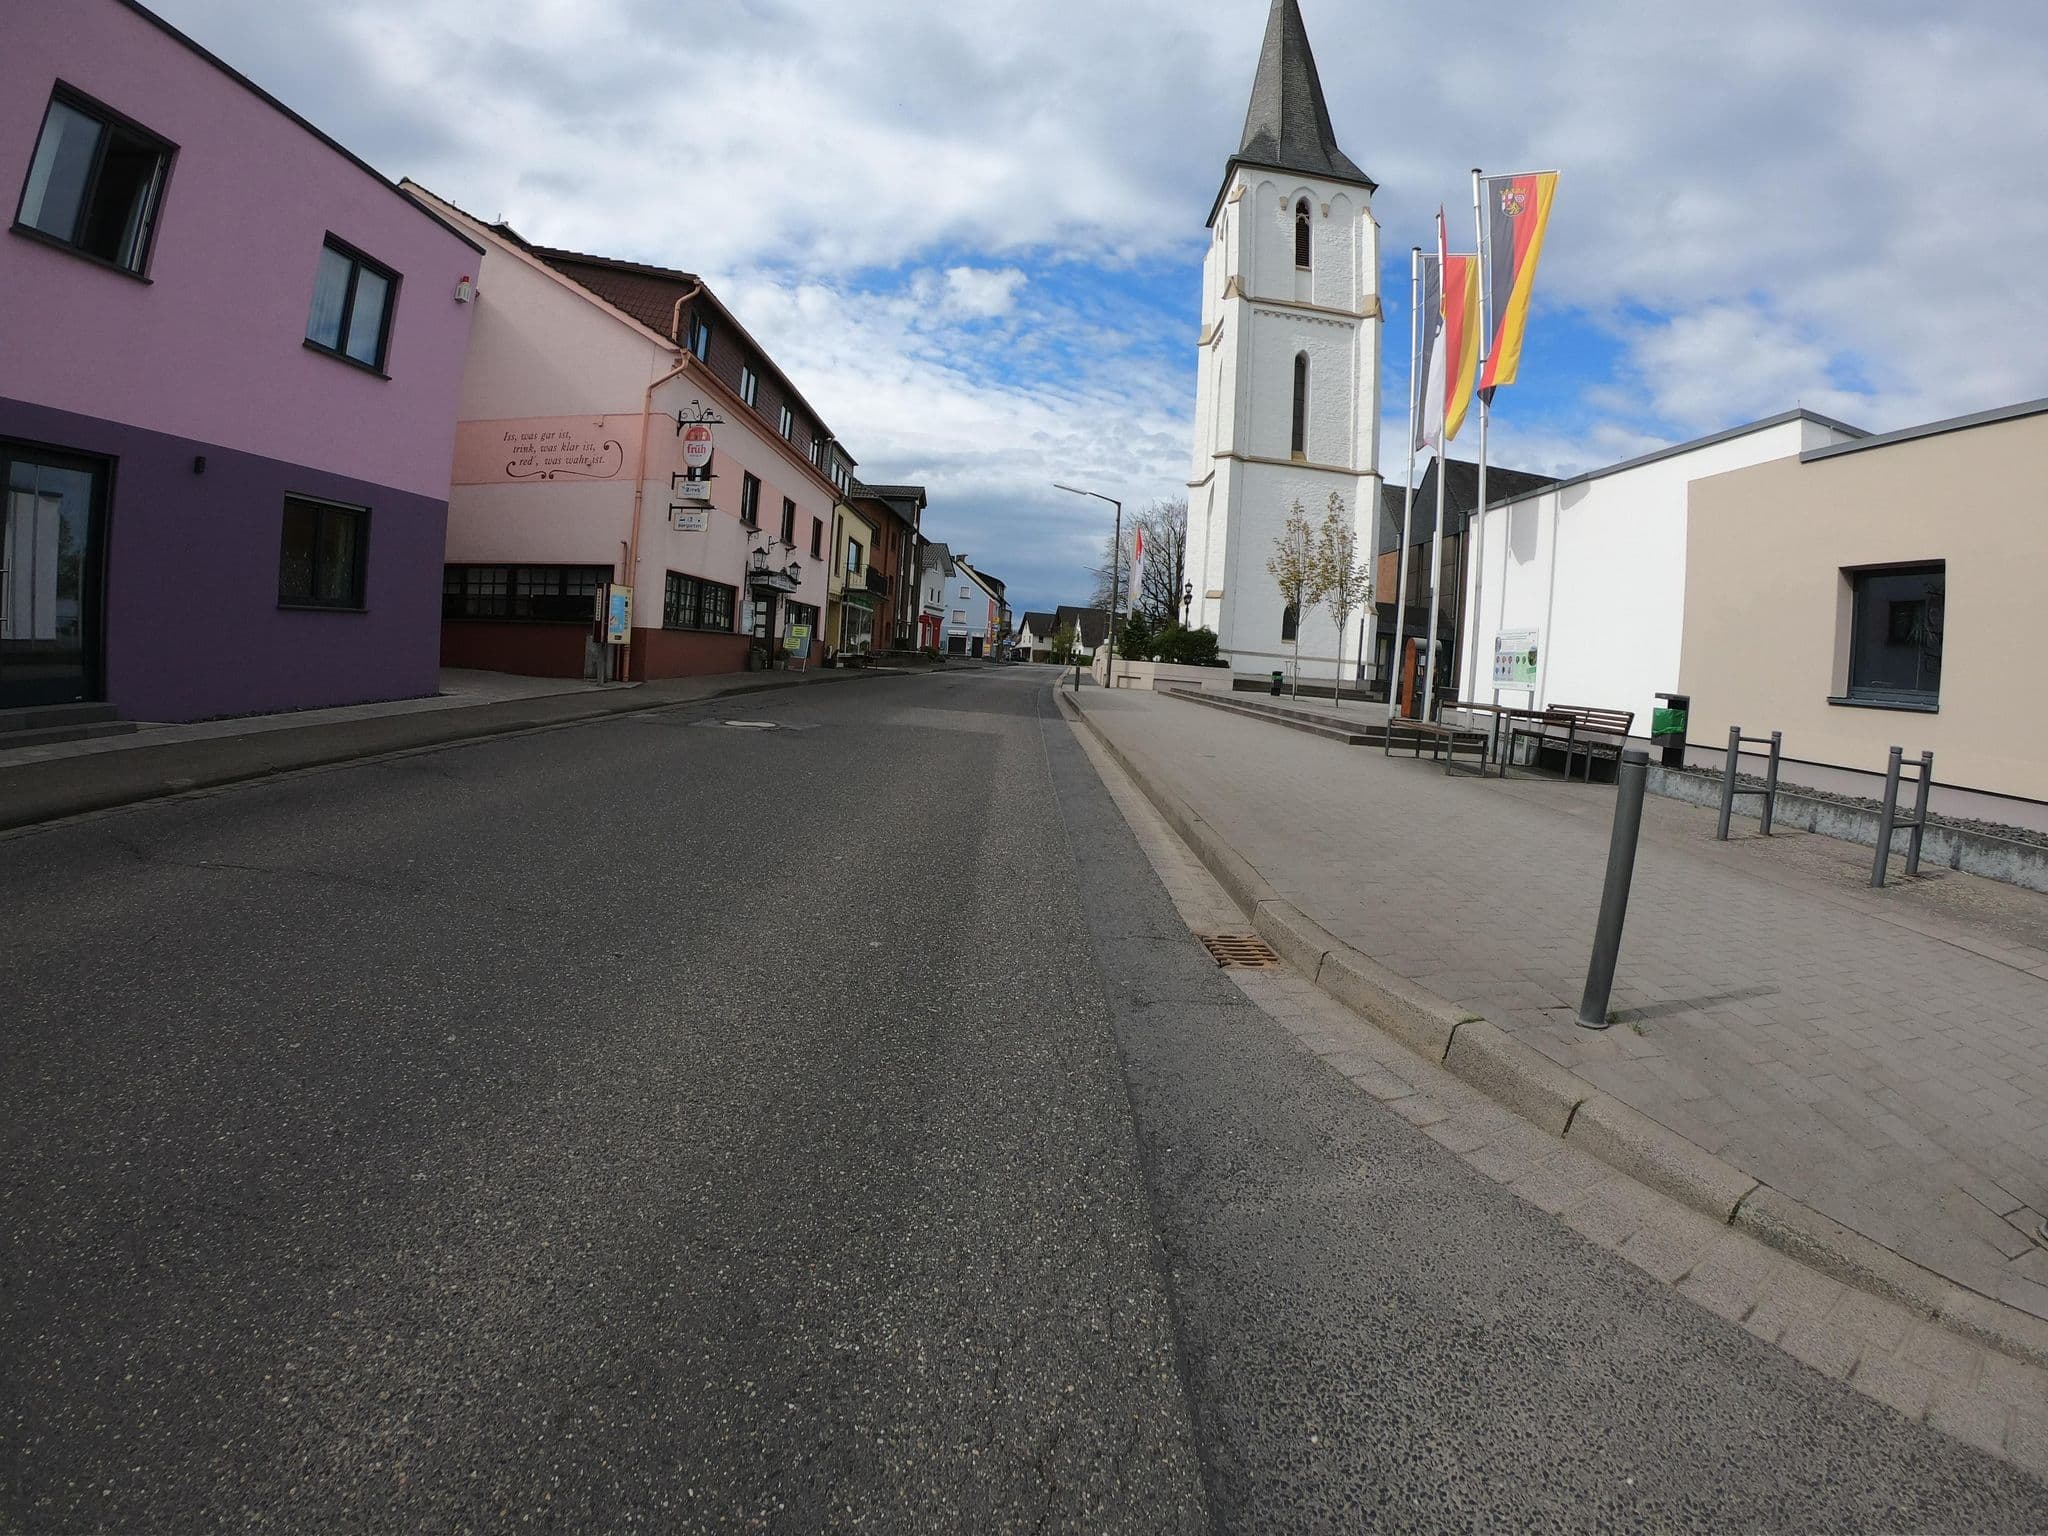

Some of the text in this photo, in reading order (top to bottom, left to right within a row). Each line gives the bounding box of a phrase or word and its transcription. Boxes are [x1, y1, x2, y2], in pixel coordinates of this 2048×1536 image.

[503, 430, 571, 441] Iss, was gar ist,
[512, 441, 596, 454] trink, was klar ist,
[687, 443, 707, 454] früh
[544, 456, 561, 465] was
[565, 454, 588, 465] wahr
[592, 455, 605, 464] ist.
